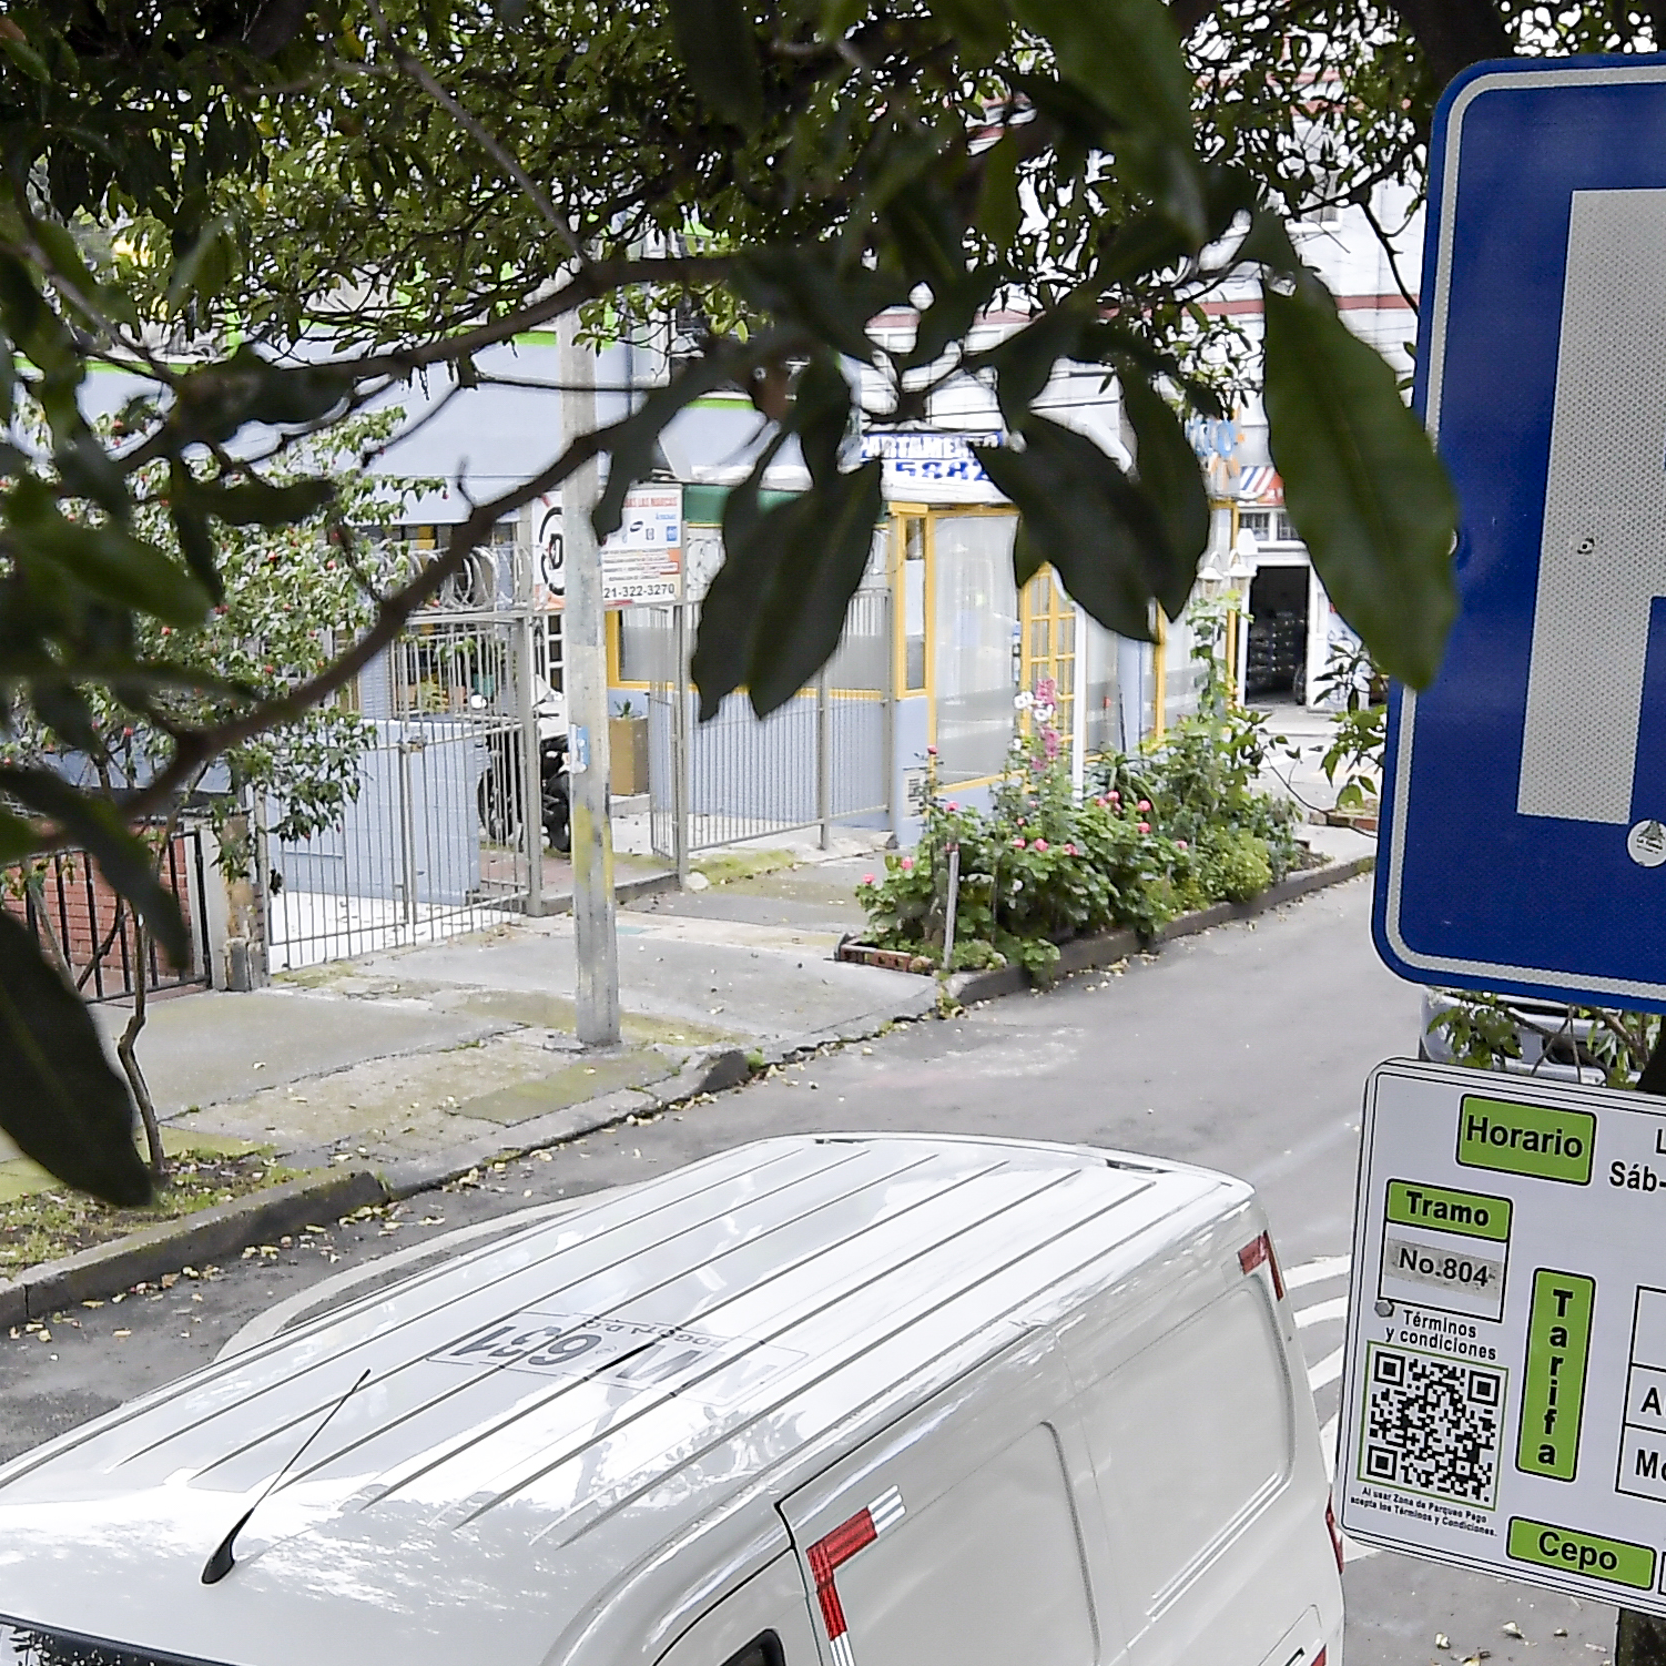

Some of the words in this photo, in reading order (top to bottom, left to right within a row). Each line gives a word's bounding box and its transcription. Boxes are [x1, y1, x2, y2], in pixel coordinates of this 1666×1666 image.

[1465, 1114, 1584, 1159] Horario
[1405, 1189, 1490, 1228] Tramo
[1399, 1247, 1489, 1287] No.804
[1402, 1309, 1477, 1339] Términos
[1386, 1328, 1395, 1344] y
[1400, 1330, 1496, 1361] condiciones
[1537, 1288, 1574, 1466] Tarifa
[1393, 1493, 1414, 1506] Zona
[1538, 1531, 1618, 1572] Cepo
